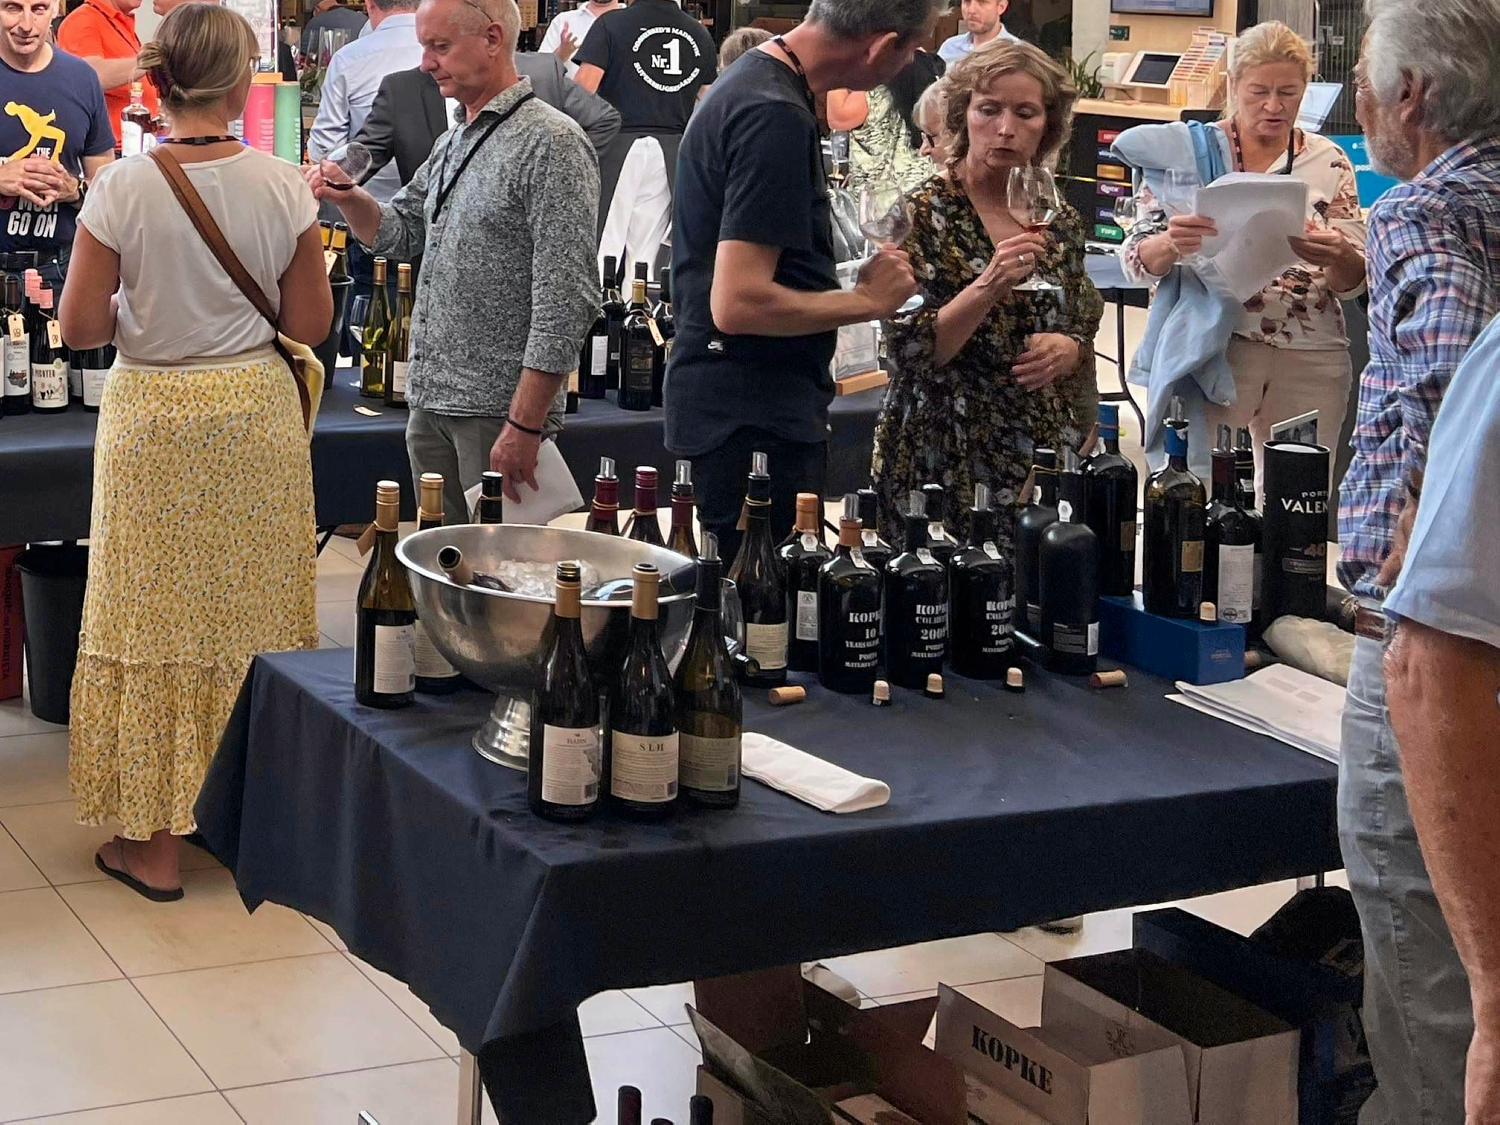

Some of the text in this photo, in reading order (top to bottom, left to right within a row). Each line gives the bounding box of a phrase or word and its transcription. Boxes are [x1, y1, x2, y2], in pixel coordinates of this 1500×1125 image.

[36, 147, 51, 159] THE
[7, 211, 57, 238] GO ON
[865, 628, 877, 639] 10
[972, 1025, 1052, 1094] KOPKE
